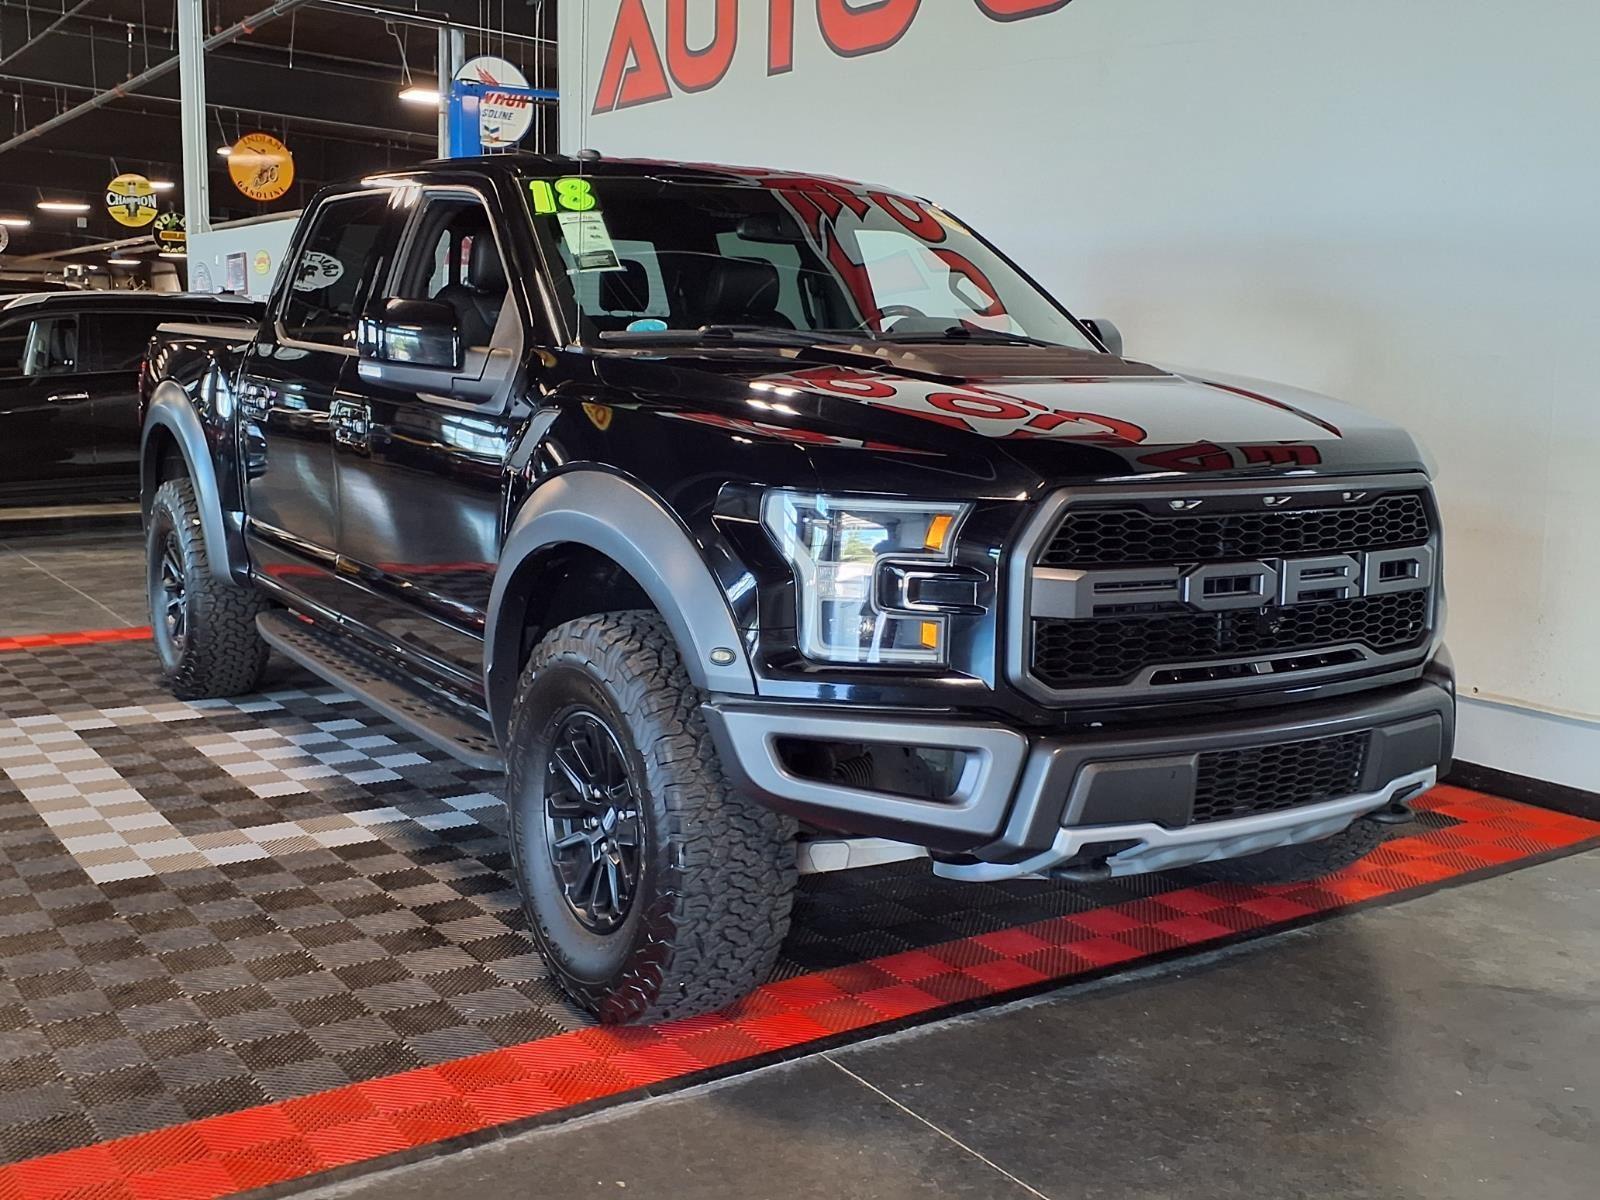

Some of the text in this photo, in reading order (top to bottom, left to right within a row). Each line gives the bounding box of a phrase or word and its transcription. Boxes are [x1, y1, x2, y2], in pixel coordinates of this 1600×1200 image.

[482, 108, 515, 120] SOLINE
[106, 191, 157, 208] CHAION
[529, 178, 596, 213] 18
[1031, 545, 1433, 619] FORD
